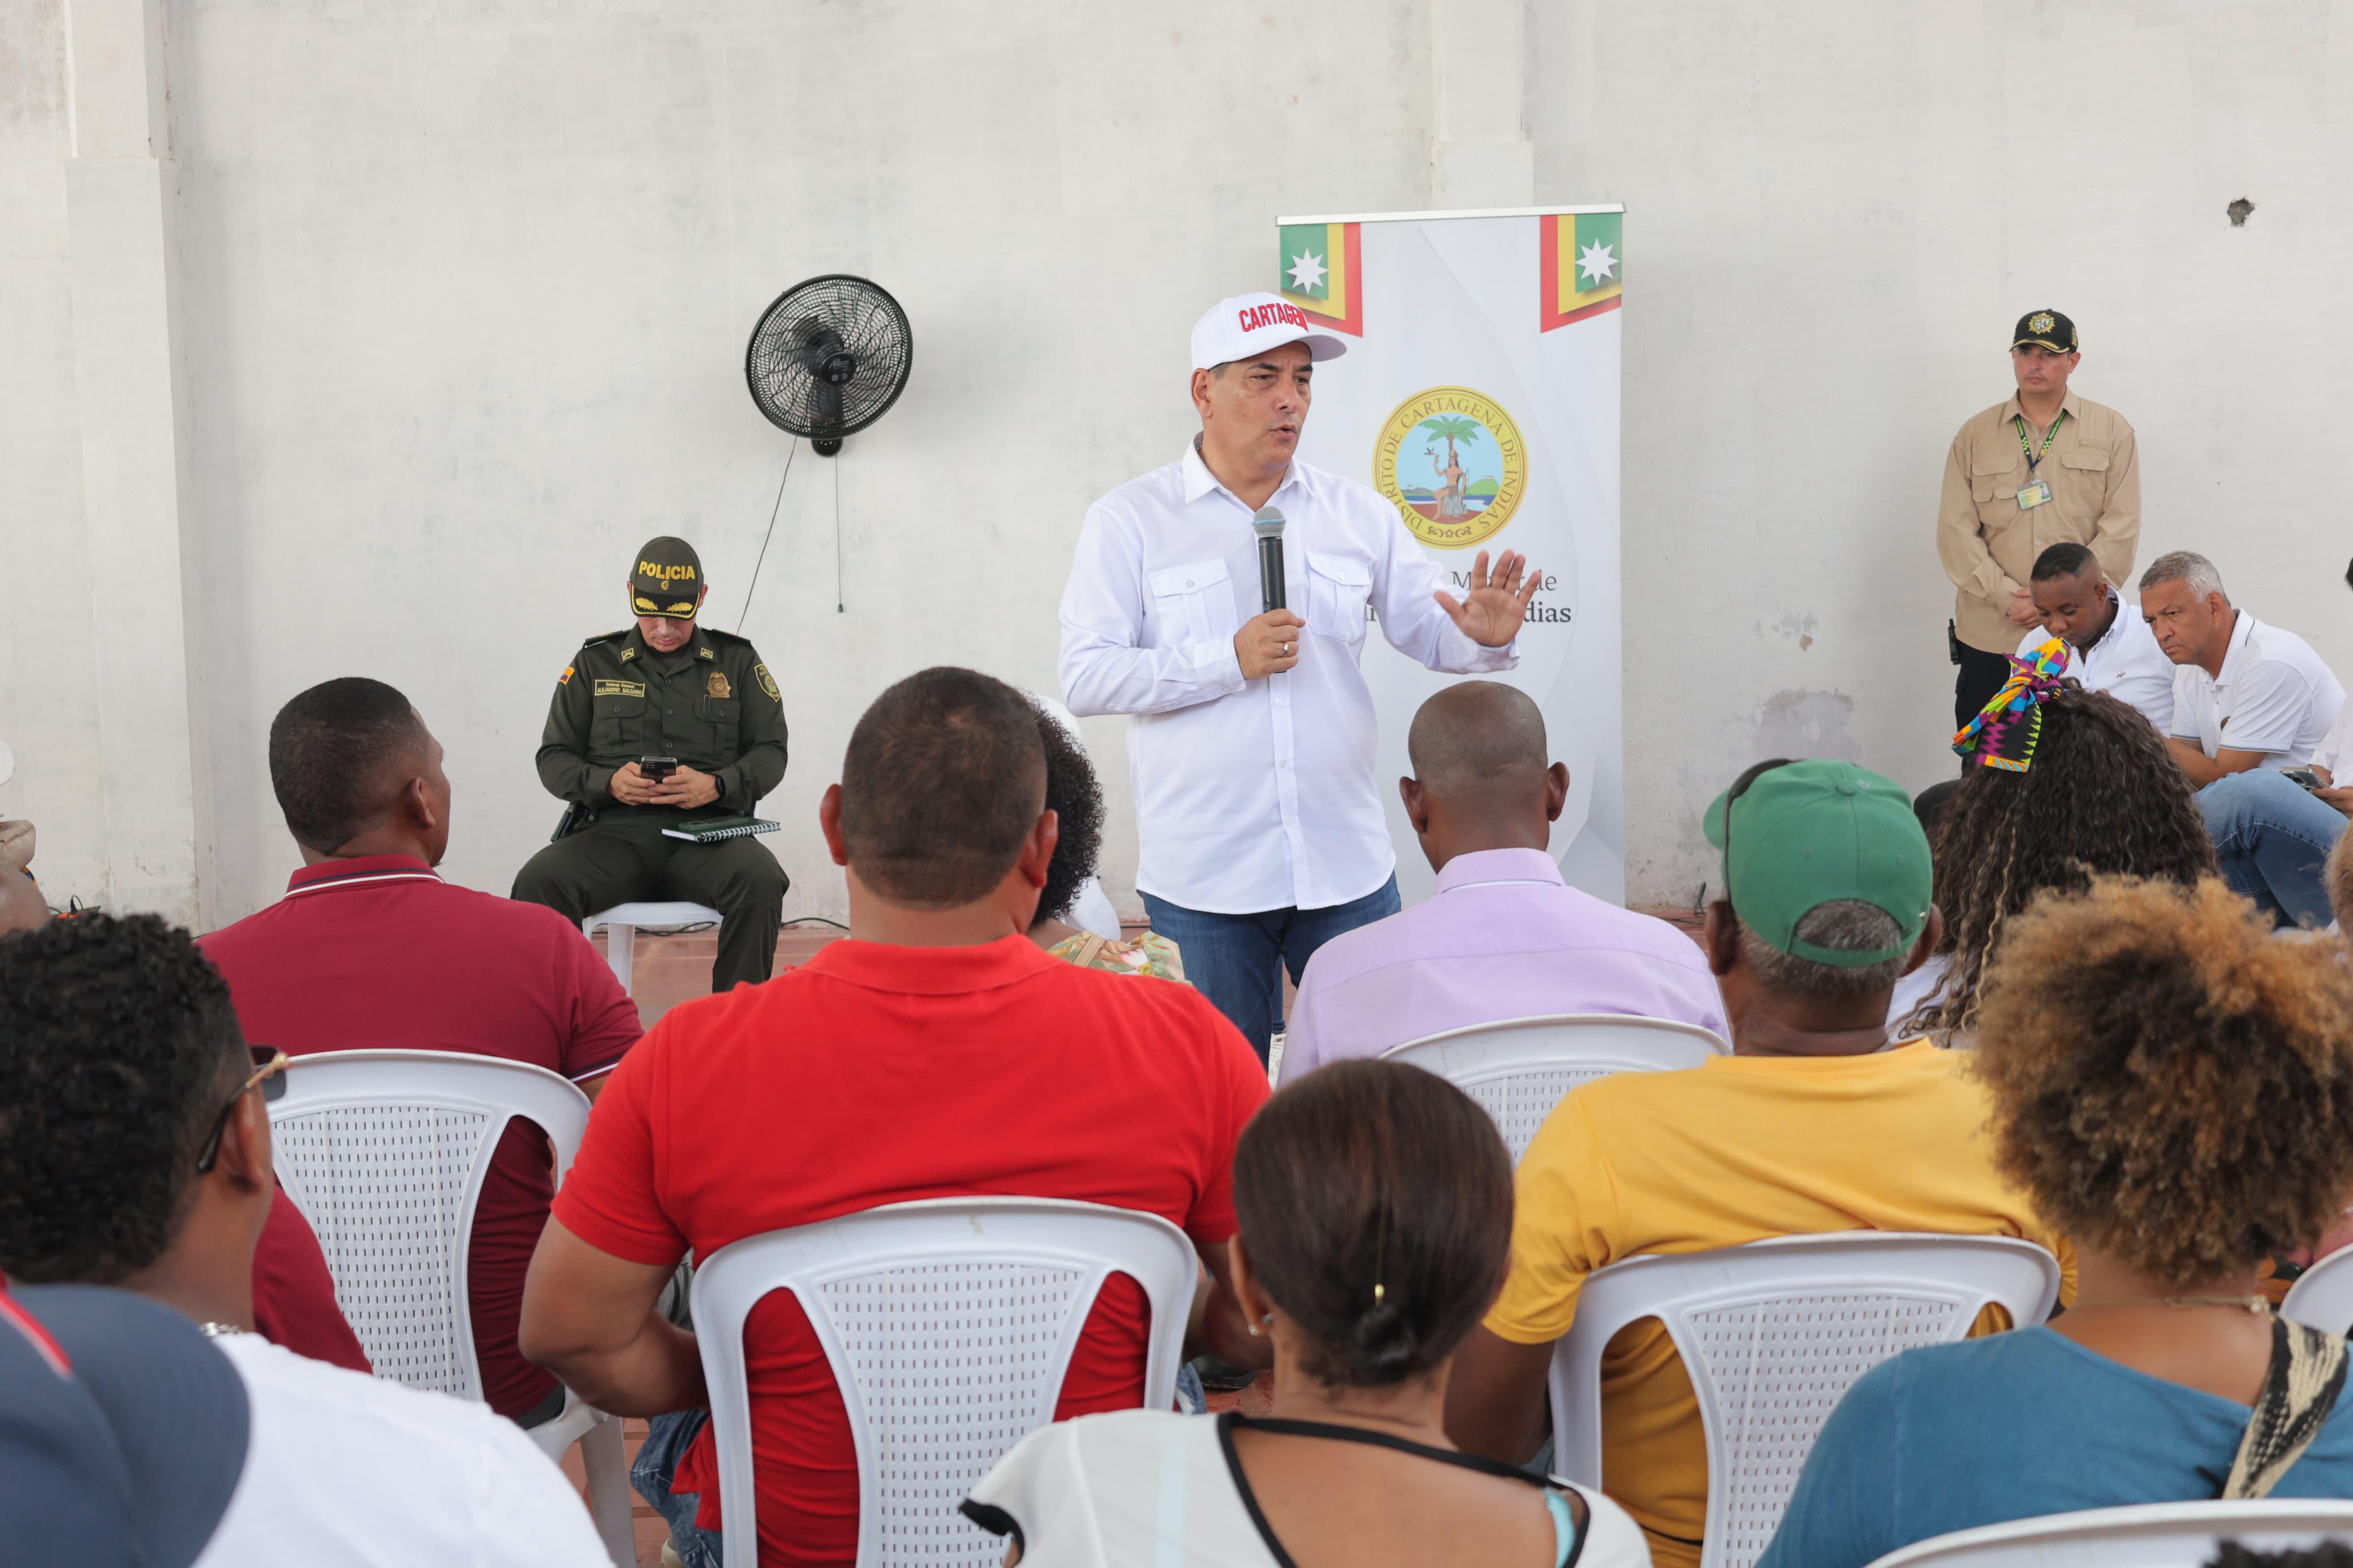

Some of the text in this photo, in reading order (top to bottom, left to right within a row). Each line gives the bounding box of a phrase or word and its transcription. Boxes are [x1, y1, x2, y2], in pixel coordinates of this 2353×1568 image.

[1400, 397, 1503, 437] CARTAGENA
[1384, 431, 1403, 455] DE
[1501, 439, 1518, 464] DE
[1478, 470, 1518, 529] INDIAS
[639, 561, 696, 580] POLICIA
[1524, 601, 1571, 623] dias
